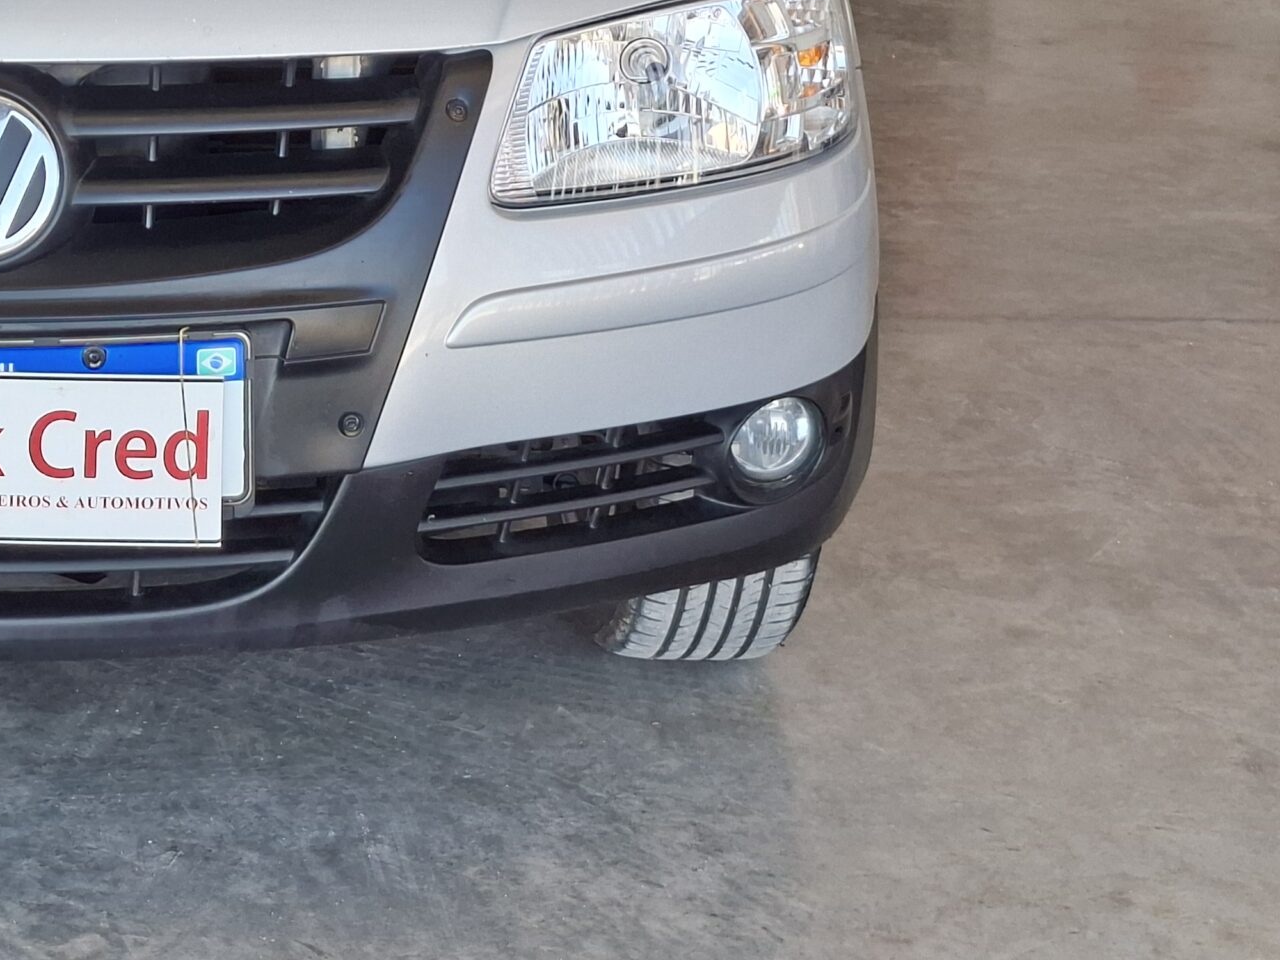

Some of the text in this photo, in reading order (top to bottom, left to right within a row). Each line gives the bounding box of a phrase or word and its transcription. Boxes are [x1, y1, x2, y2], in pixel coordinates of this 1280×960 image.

[28, 409, 209, 481] Cred
[56, 495, 69, 509] &
[73, 493, 209, 511] AUTOMOTIVOS
